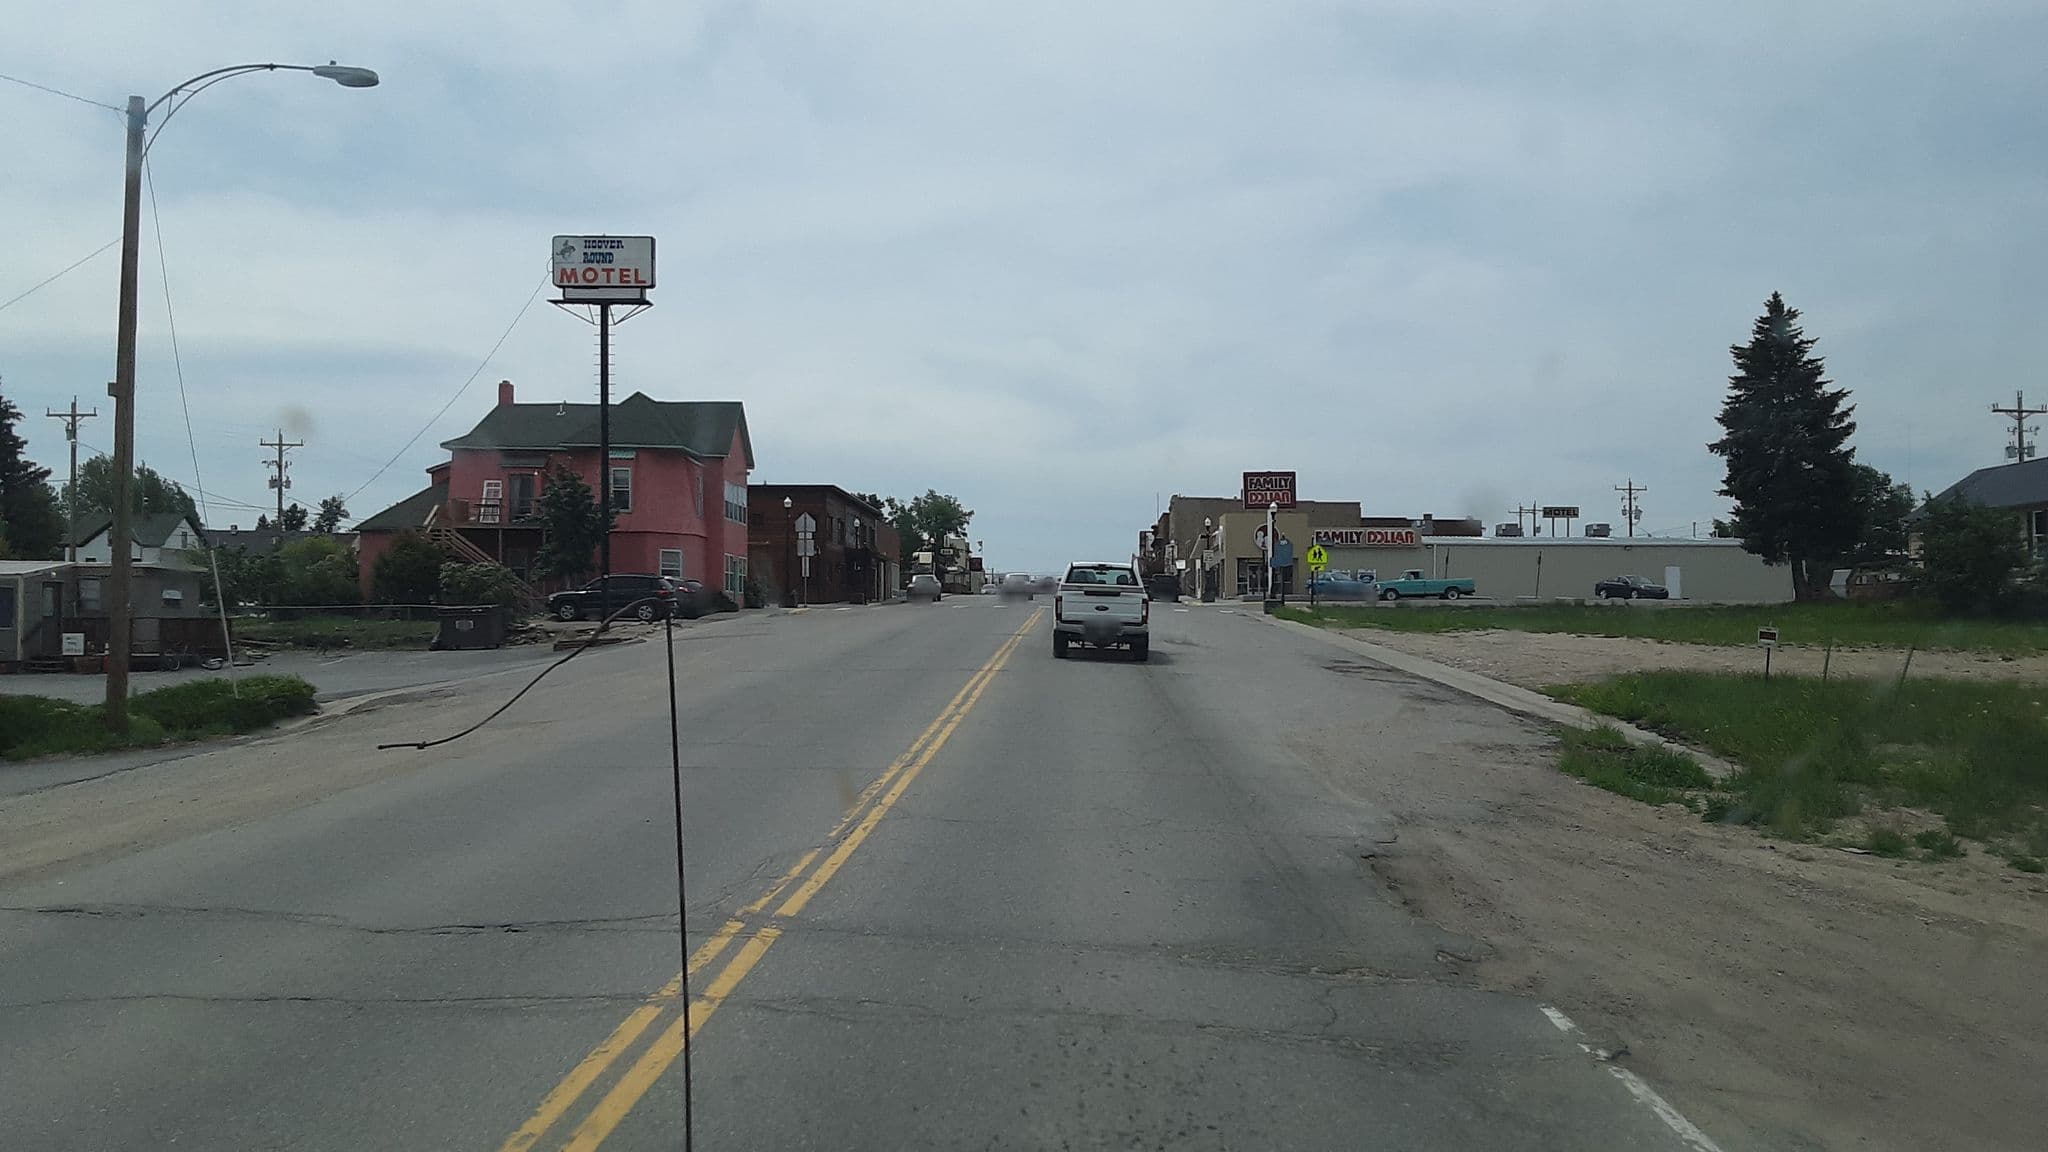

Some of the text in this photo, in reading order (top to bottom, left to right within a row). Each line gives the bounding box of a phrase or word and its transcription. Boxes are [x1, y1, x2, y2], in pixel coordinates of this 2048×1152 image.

[584, 240, 624, 249] HOOVER
[583, 252, 614, 264] ROUND
[559, 267, 646, 283] MOTEL
[1249, 477, 1291, 489] FAMILY
[1249, 491, 1291, 504] DOLLAR
[1315, 530, 1415, 544] FAMILY DOLLAR
